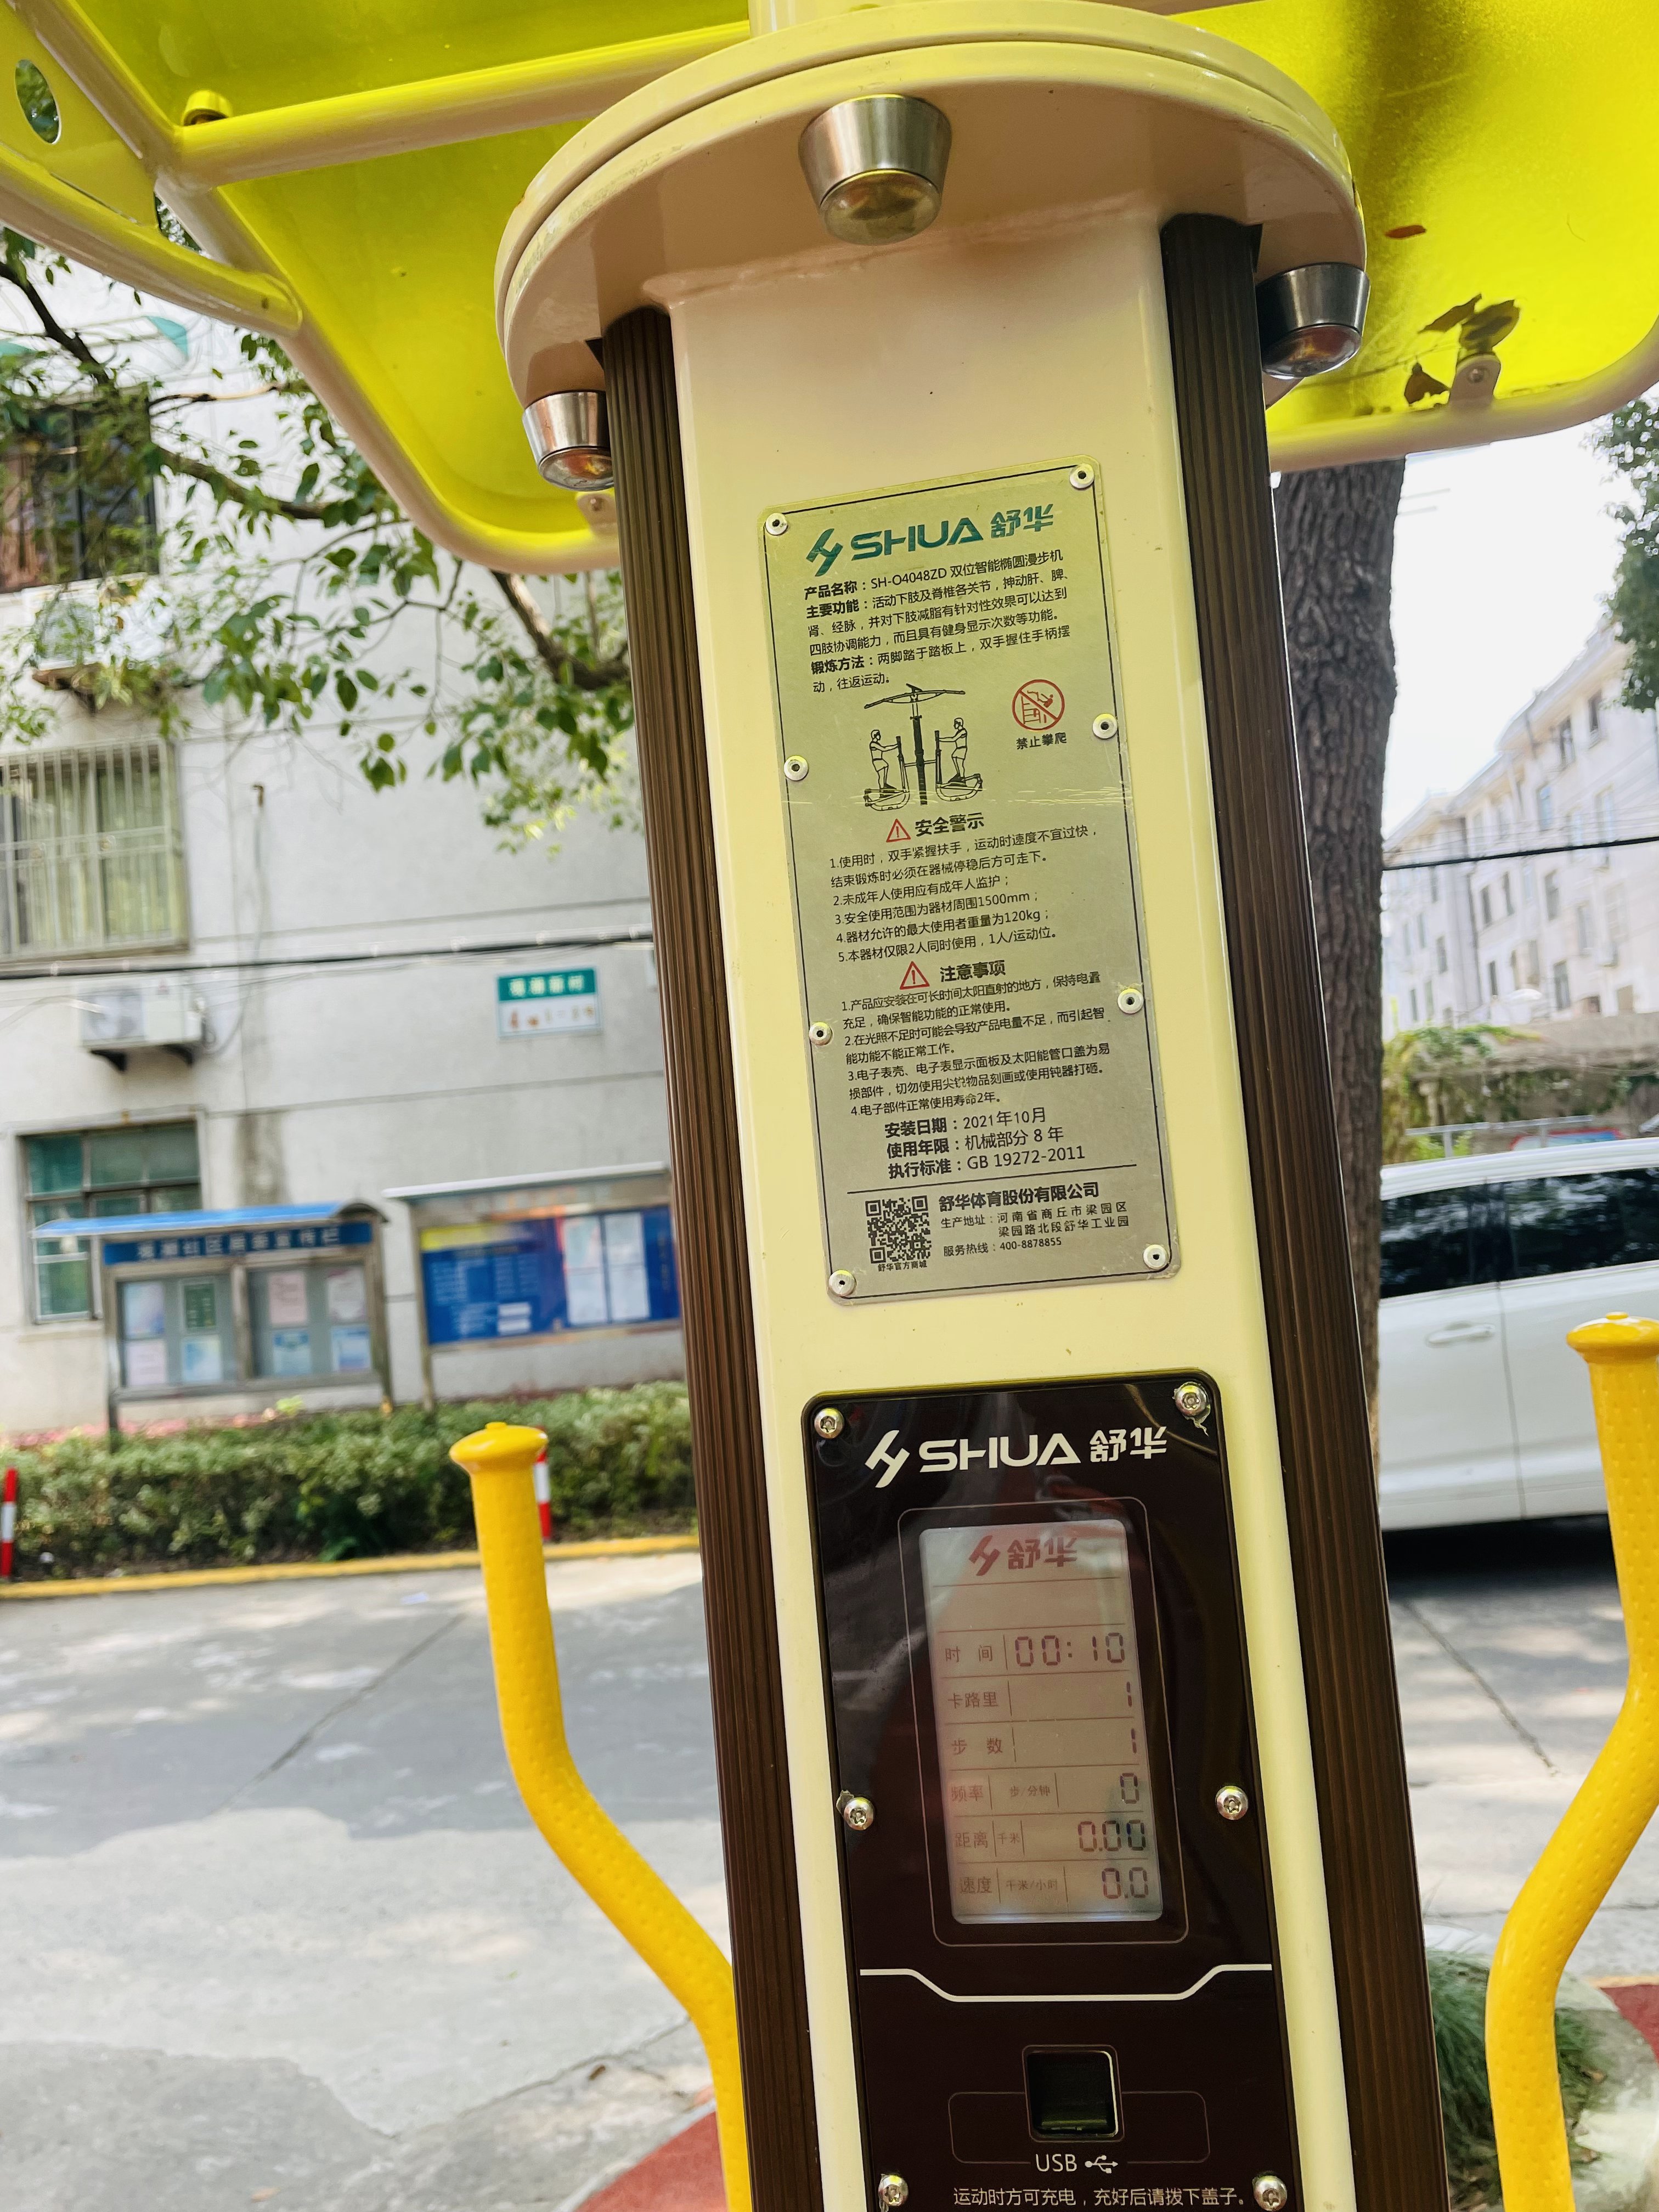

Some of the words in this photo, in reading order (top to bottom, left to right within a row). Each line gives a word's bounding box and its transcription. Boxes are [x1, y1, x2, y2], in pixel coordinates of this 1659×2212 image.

[851, 517, 983, 561] SHUA
[990, 504, 1054, 539] 舒华
[1016, 732, 1067, 750] 禁止攀爬
[915, 812, 984, 837] 安全警示
[940, 960, 1006, 983] 注意事项
[845, 1042, 955, 1065] 能功能不能正常工作。
[1034, 1129, 1042, 1142] 8
[1047, 1126, 1064, 1142] 年
[995, 1146, 1085, 1169] 19272-2011
[938, 1182, 1099, 1212] 舒华体育股份有限公司
[878, 1260, 927, 1272] 舒华官方商城
[919, 1433, 1081, 1472] SHUA
[1090, 1426, 1167, 1463] 舒华
[1007, 1537, 1078, 1570] 舒华
[1014, 1632, 1126, 1667] 00:10
[947, 1691, 999, 1709] 卡路里
[951, 1784, 984, 1802] 频率
[1120, 1773, 1140, 1804] 0
[955, 1830, 988, 1849] 距离
[997, 1831, 1021, 1846] 千米
[1077, 1819, 1147, 1853] 0.00
[959, 1875, 992, 1894] 速度
[1102, 1866, 1149, 1899] 0.0
[1035, 2154, 1077, 2172] USB
